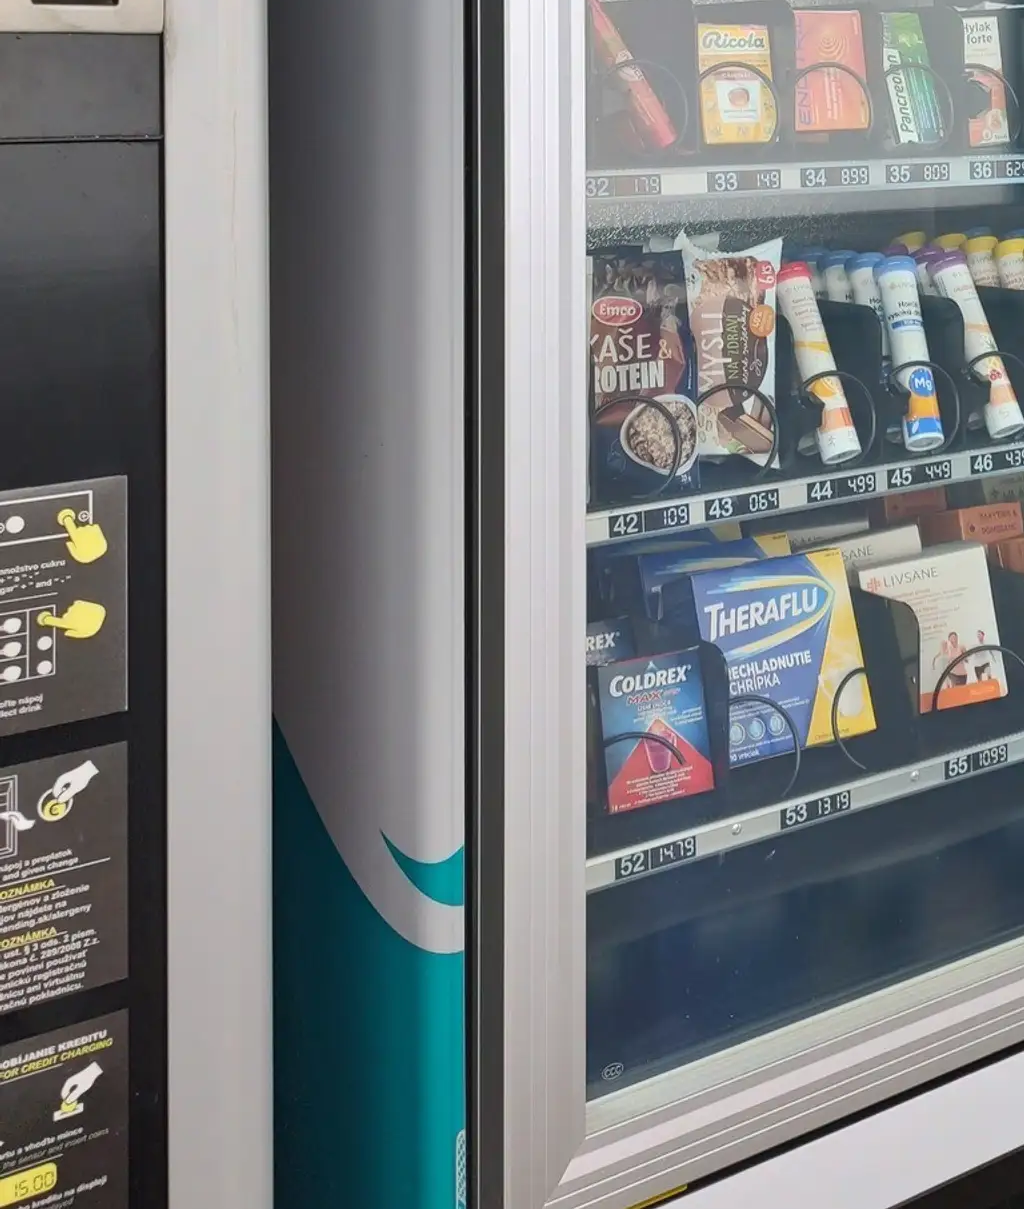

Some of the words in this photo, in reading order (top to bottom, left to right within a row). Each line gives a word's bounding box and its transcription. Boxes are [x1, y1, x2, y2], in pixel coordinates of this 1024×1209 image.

[702, 30, 765, 50] Ricola
[714, 173, 738, 192] 33
[757, 171, 780, 189] 149
[805, 168, 827, 187] 34
[841, 167, 869, 185] 899
[889, 165, 911, 183] 35
[923, 163, 949, 181] 809
[973, 162, 992, 179] 36
[585, 176, 610, 197] 32
[634, 176, 660, 194] 179
[913, 372, 932, 391] Mg
[890, 467, 913, 487] 45
[925, 461, 951, 479] 449
[973, 454, 993, 472] 46
[810, 480, 833, 501] 44
[848, 473, 875, 493] 499
[708, 497, 734, 519] 43
[749, 491, 778, 512] 064
[613, 514, 639, 535] 42
[663, 506, 688, 526] 109
[883, 567, 939, 589] LIVSANE
[704, 587, 818, 643] THERAFLU
[728, 650, 813, 680] ECHLADNUTIE
[609, 667, 688, 698] COLDREX
[948, 756, 968, 777] 55
[785, 803, 808, 826] 53
[620, 852, 646, 876] 52
[57, 1029, 108, 1052] KREDITU
[20, 1054, 59, 1074] CREDIT
[59, 1037, 114, 1061] CHARGING
